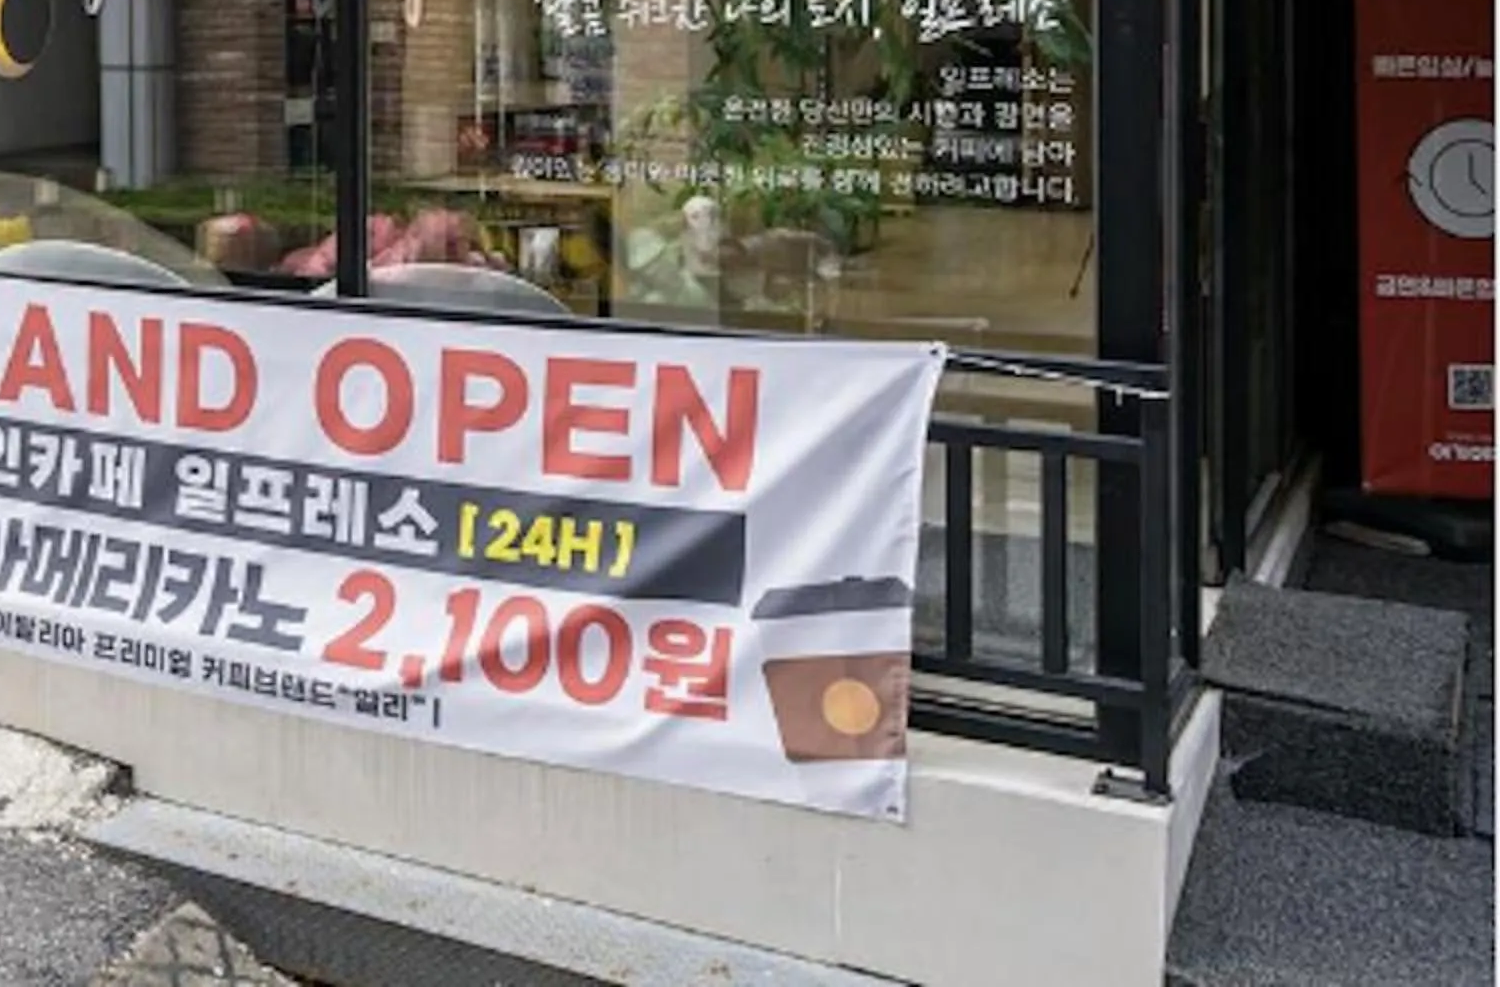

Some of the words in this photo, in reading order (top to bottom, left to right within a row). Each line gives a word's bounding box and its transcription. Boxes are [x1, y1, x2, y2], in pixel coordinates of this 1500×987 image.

[313, 336, 761, 493] OPEN
[173, 453, 439, 558] 일프레소
[92, 630, 194, 680] 프리미엄
[321, 568, 736, 723] 2,100원
